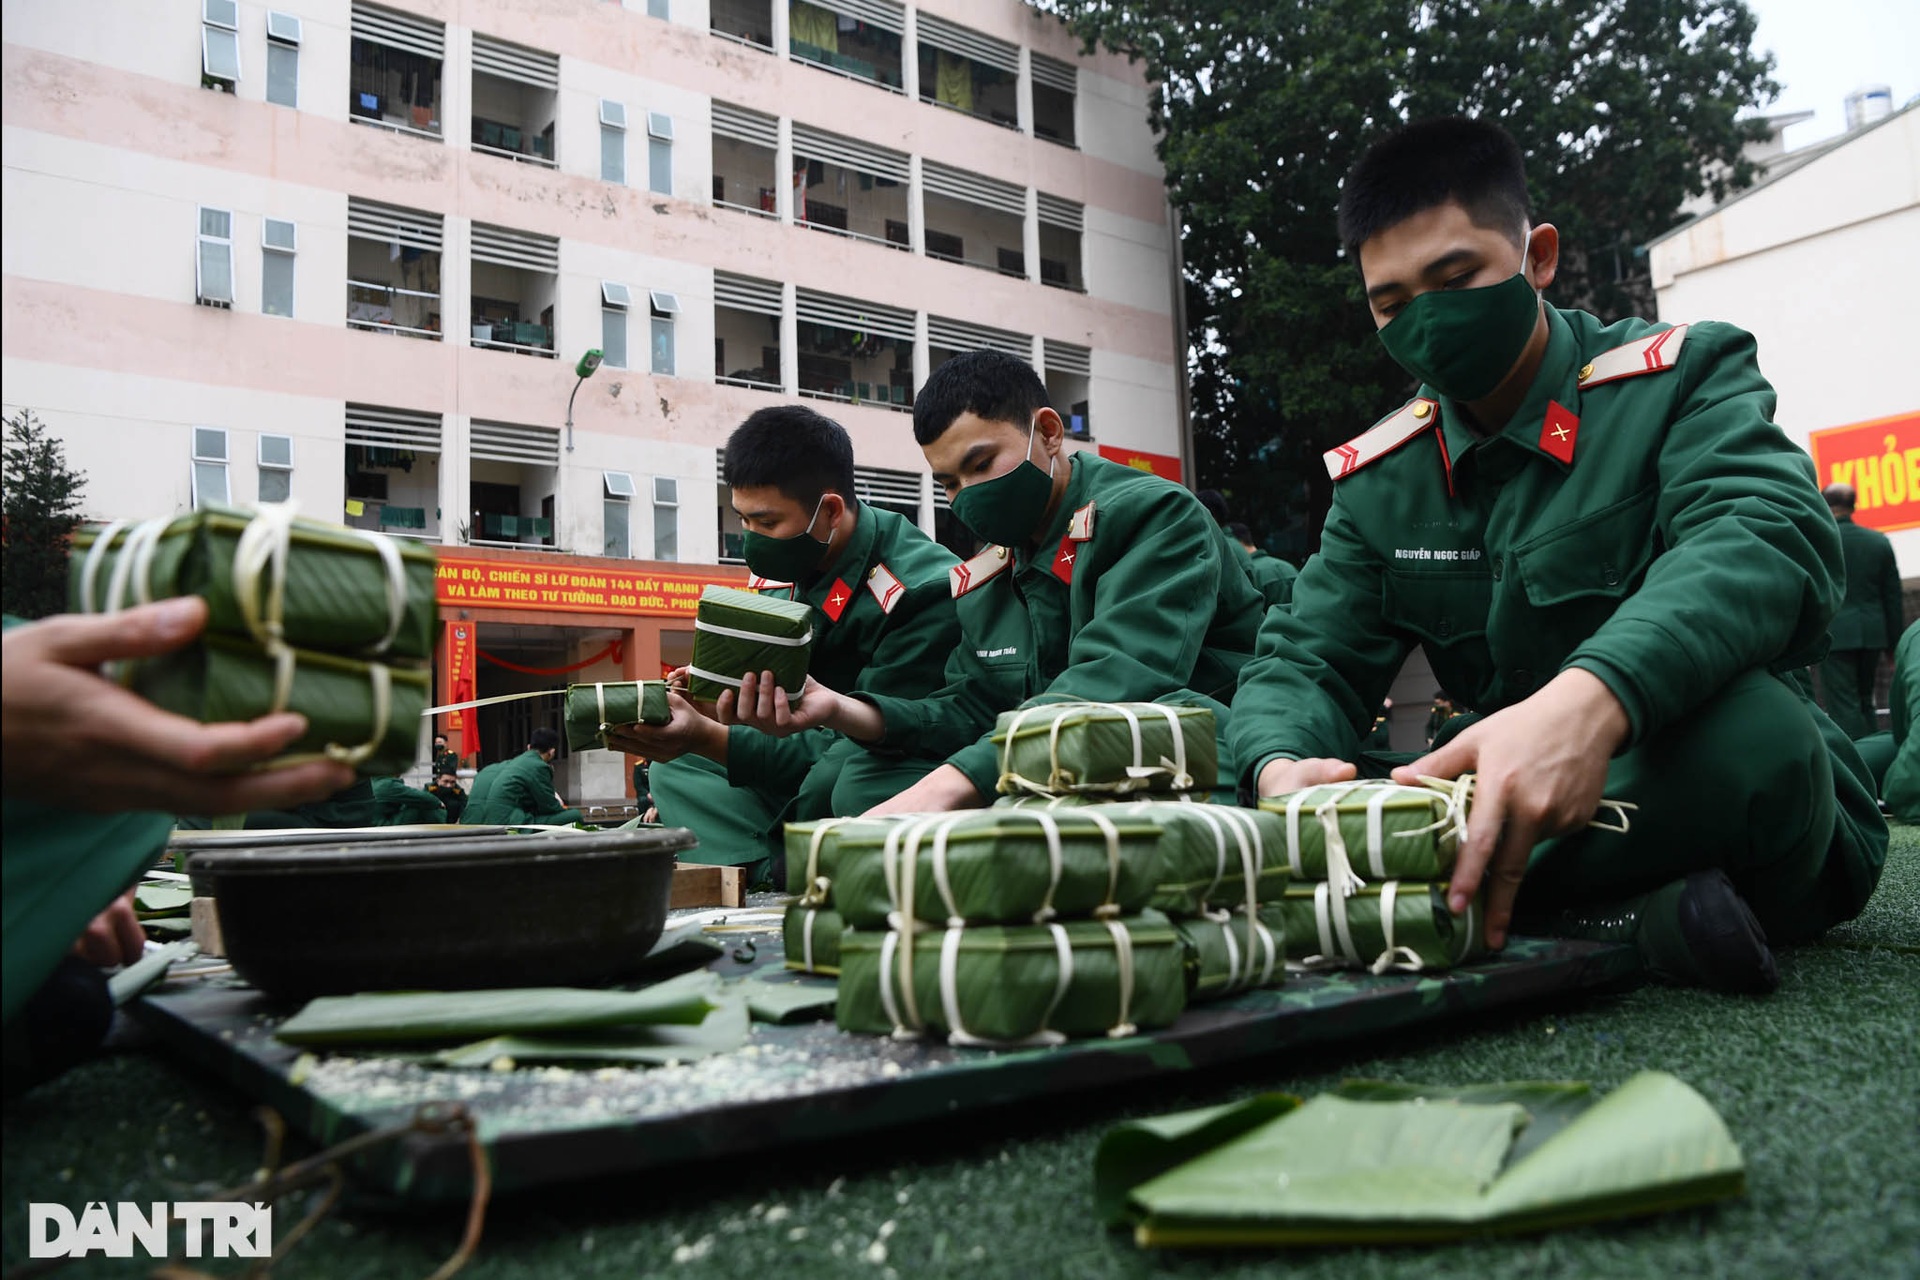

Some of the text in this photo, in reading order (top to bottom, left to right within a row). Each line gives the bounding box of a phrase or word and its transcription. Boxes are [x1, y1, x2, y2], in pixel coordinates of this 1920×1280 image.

[1395, 547, 1481, 561] NGUYỄN NGỌC GIÁP
[489, 569, 531, 584] CHIẾN
[571, 575, 607, 588] ĐOÀN
[611, 578, 633, 590] 144
[663, 581, 699, 594] MẠNH
[447, 583, 466, 597] VÀ
[470, 584, 500, 599] LÀM
[504, 588, 538, 601] THEO
[611, 594, 636, 607] ĐẠO
